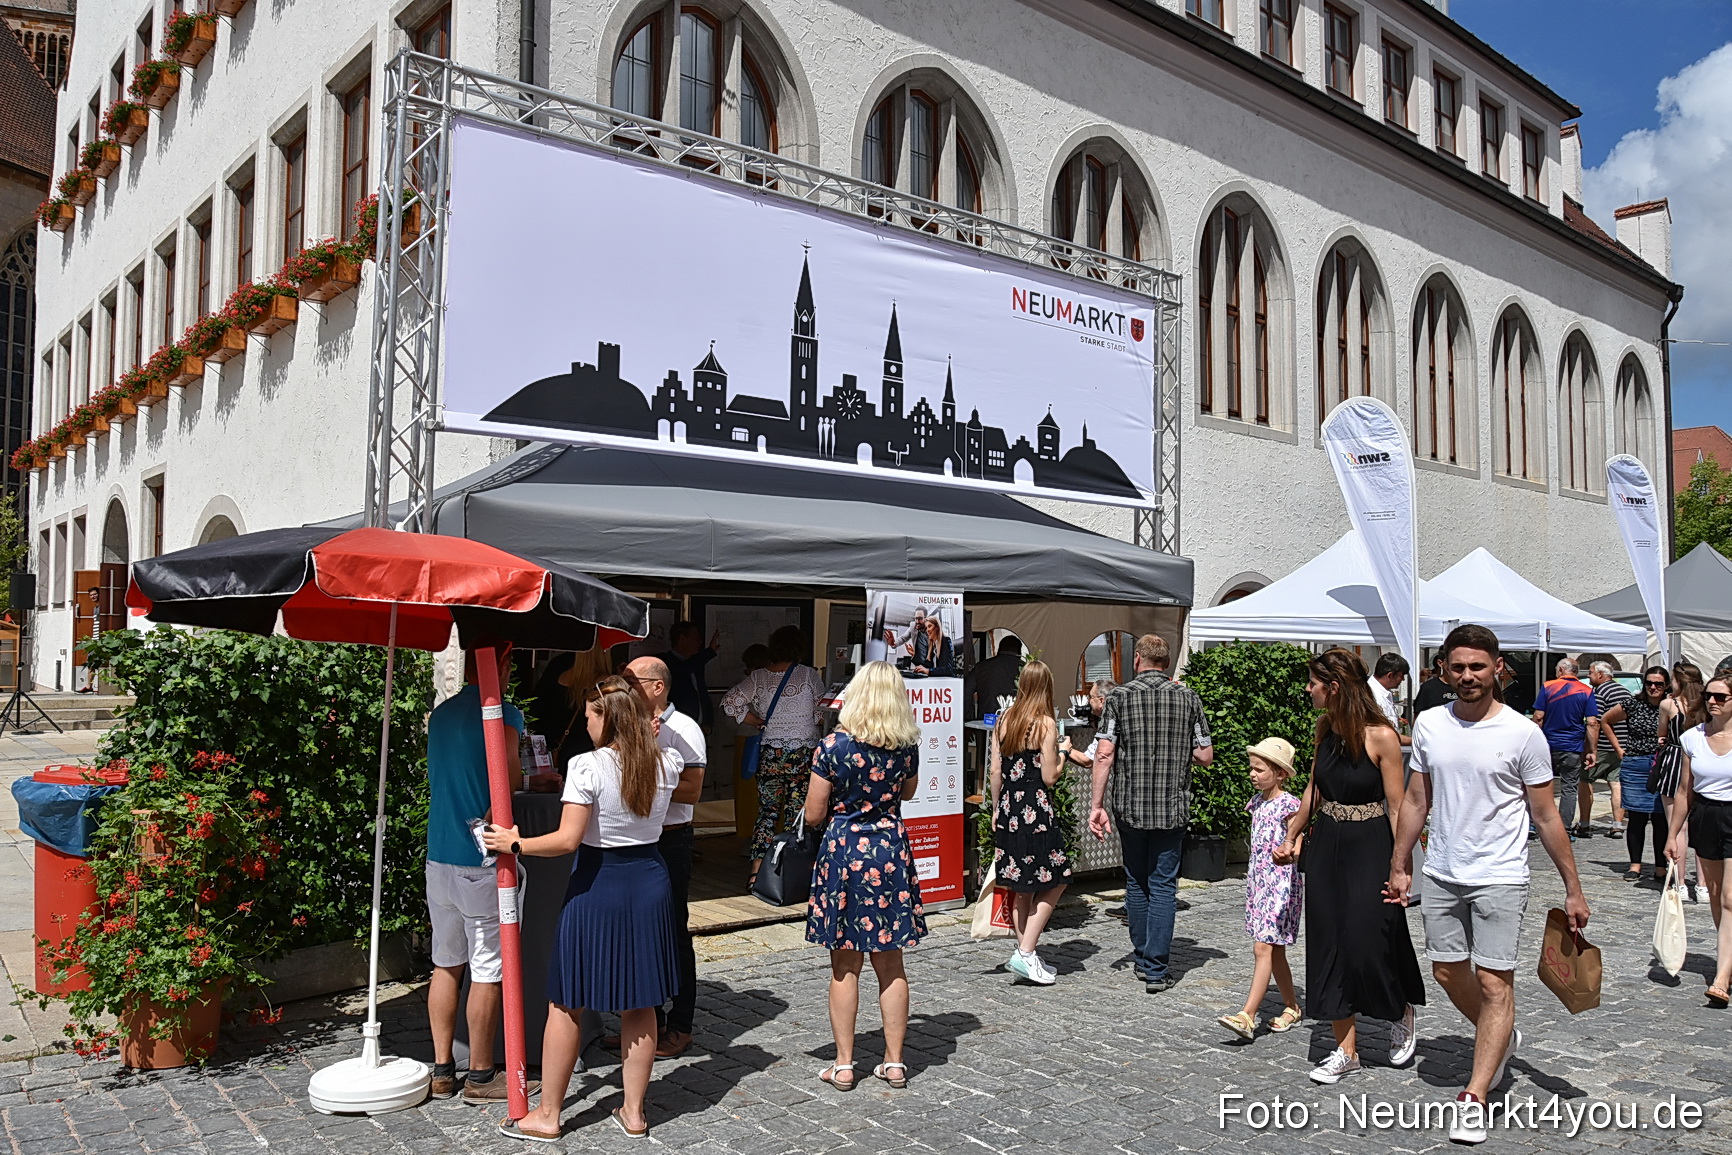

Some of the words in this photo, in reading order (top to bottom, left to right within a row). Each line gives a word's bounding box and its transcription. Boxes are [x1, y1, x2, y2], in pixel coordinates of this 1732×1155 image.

[1012, 287, 1125, 336] NEUMARKT
[1080, 336, 1105, 348] STARKE
[1106, 344, 1126, 352] STADT
[918, 596, 953, 605] NEUMARKT
[929, 688, 952, 704] INS
[923, 707, 952, 723] BAU
